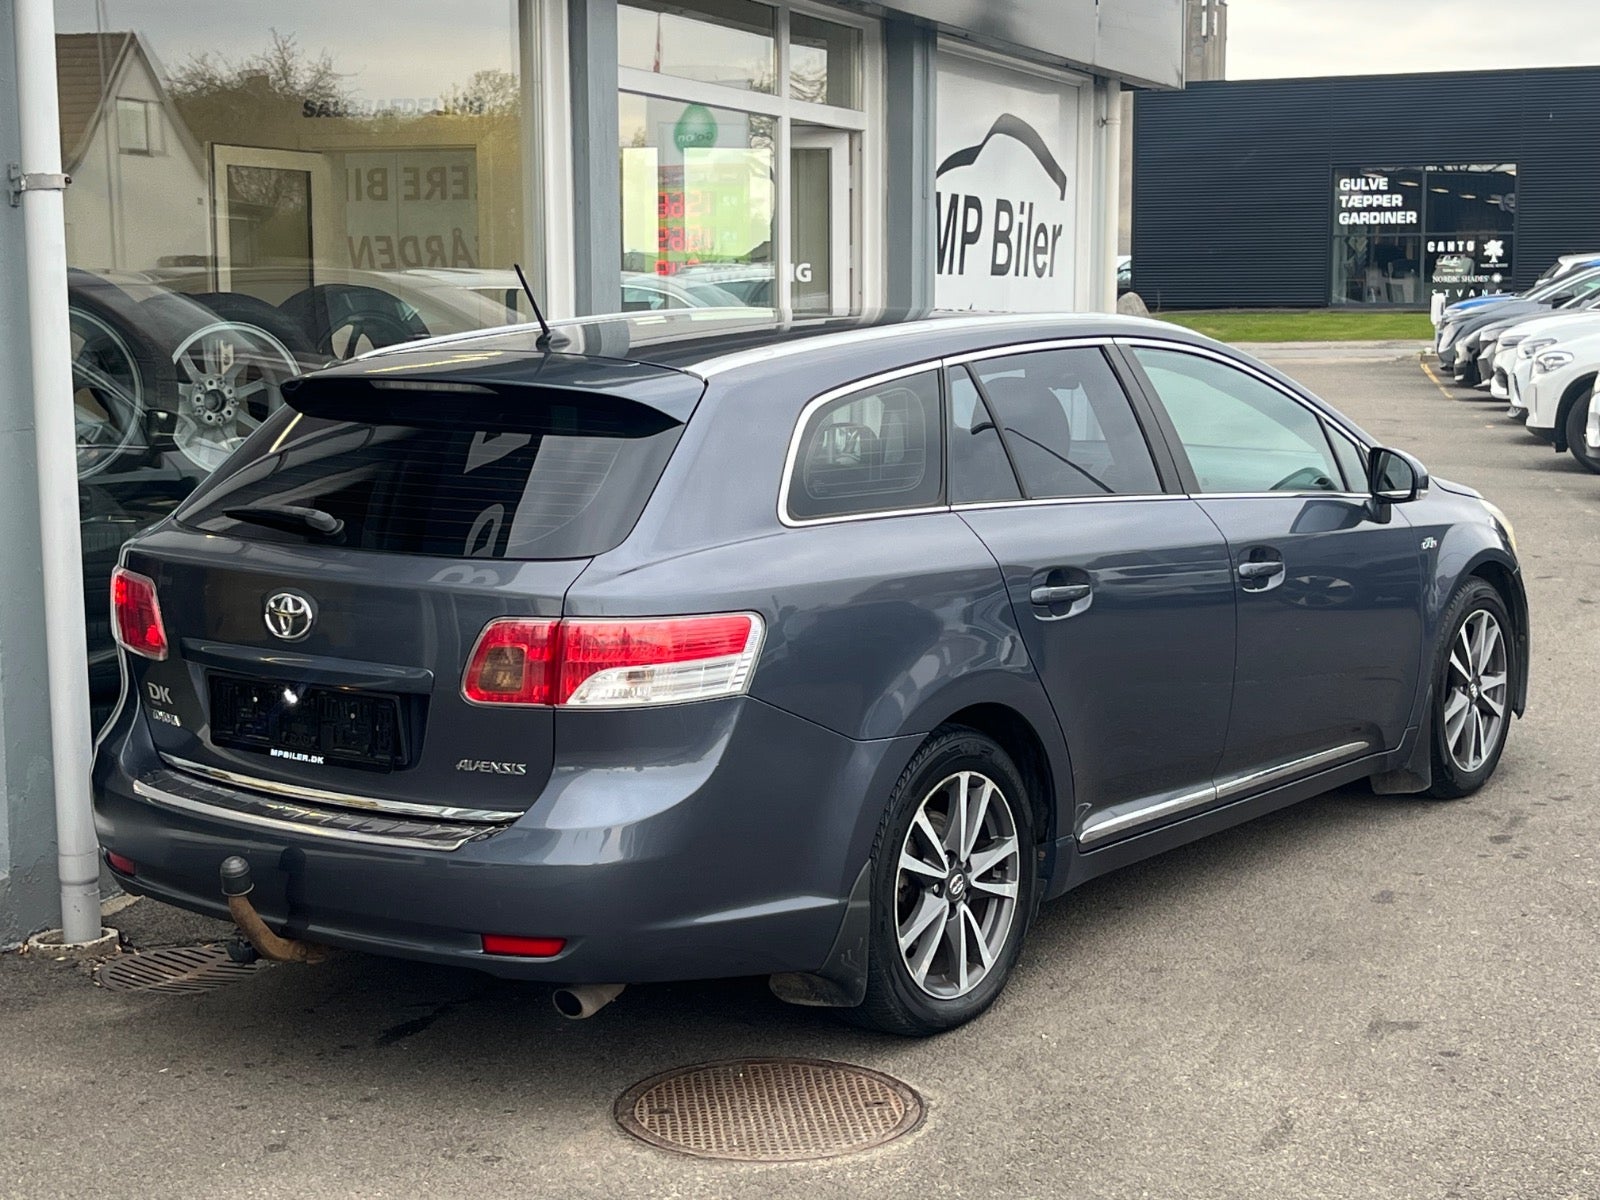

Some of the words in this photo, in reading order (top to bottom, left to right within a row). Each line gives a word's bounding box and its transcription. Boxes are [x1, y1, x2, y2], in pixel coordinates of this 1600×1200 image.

[1339, 177, 1388, 191] GULVE
[1339, 194, 1403, 208] TÆPPER
[1338, 211, 1417, 225] GARDINER
[936, 191, 983, 275] MP
[990, 198, 1063, 279] Biler
[1432, 276, 1460, 284] NORDIC
[147, 682, 173, 705] DK
[269, 748, 325, 765] MPBILER.DK
[455, 759, 527, 775] AVENSIS
